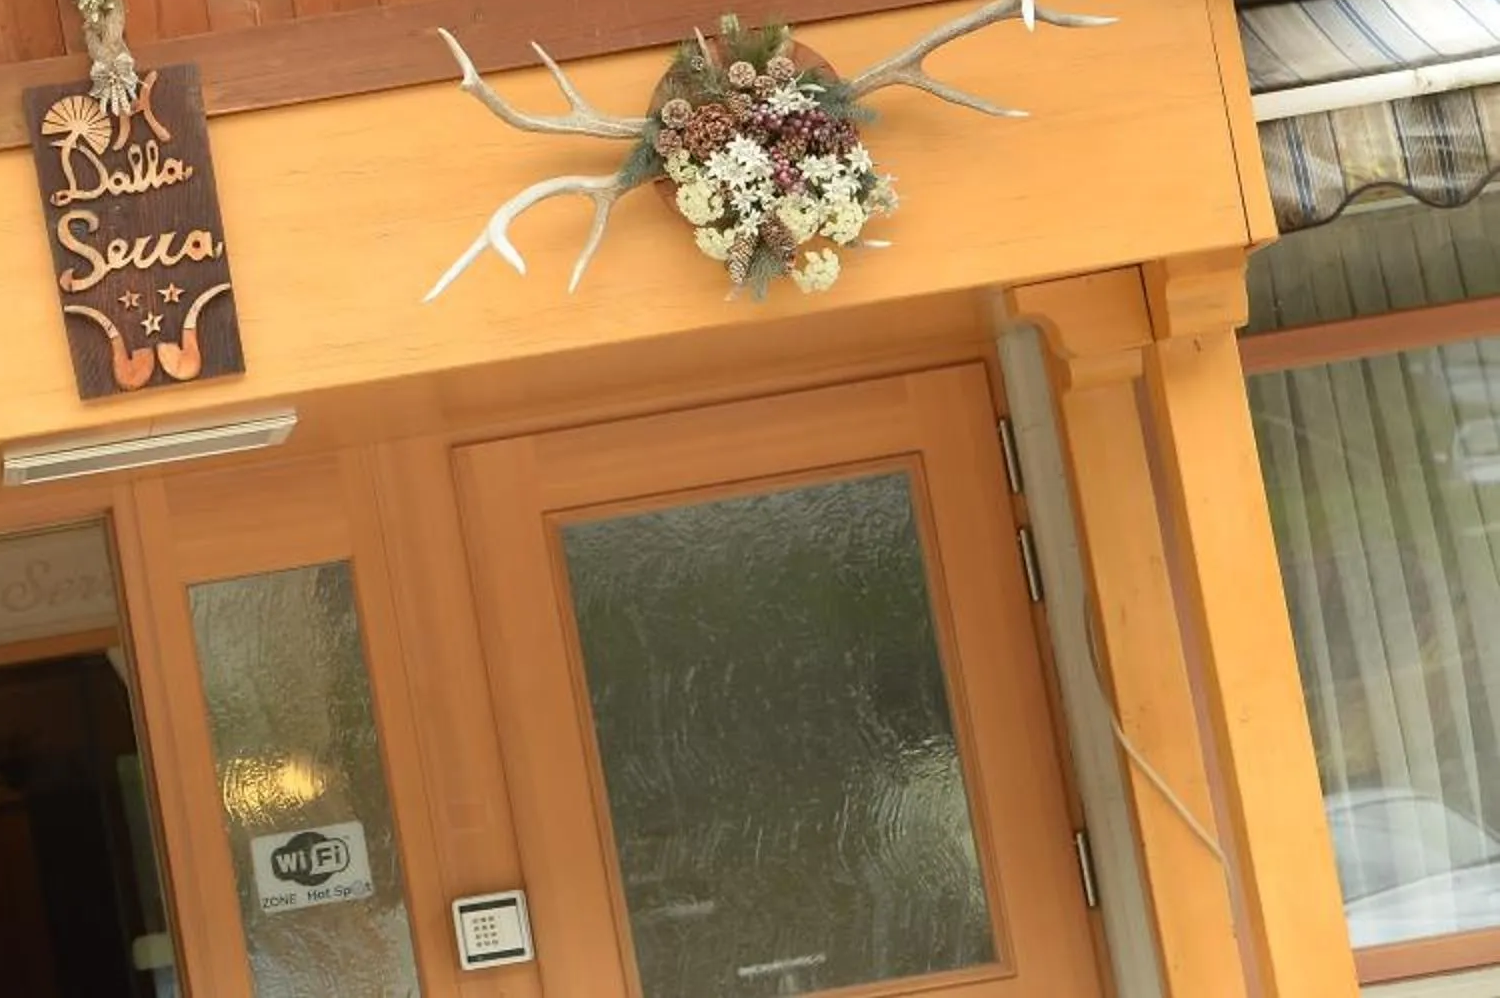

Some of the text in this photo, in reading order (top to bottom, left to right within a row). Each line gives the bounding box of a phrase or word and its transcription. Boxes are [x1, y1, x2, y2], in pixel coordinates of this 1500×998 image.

[50, 139, 193, 207] Dalla
[57, 209, 224, 293] Serra
[262, 892, 298, 909] ZONE
